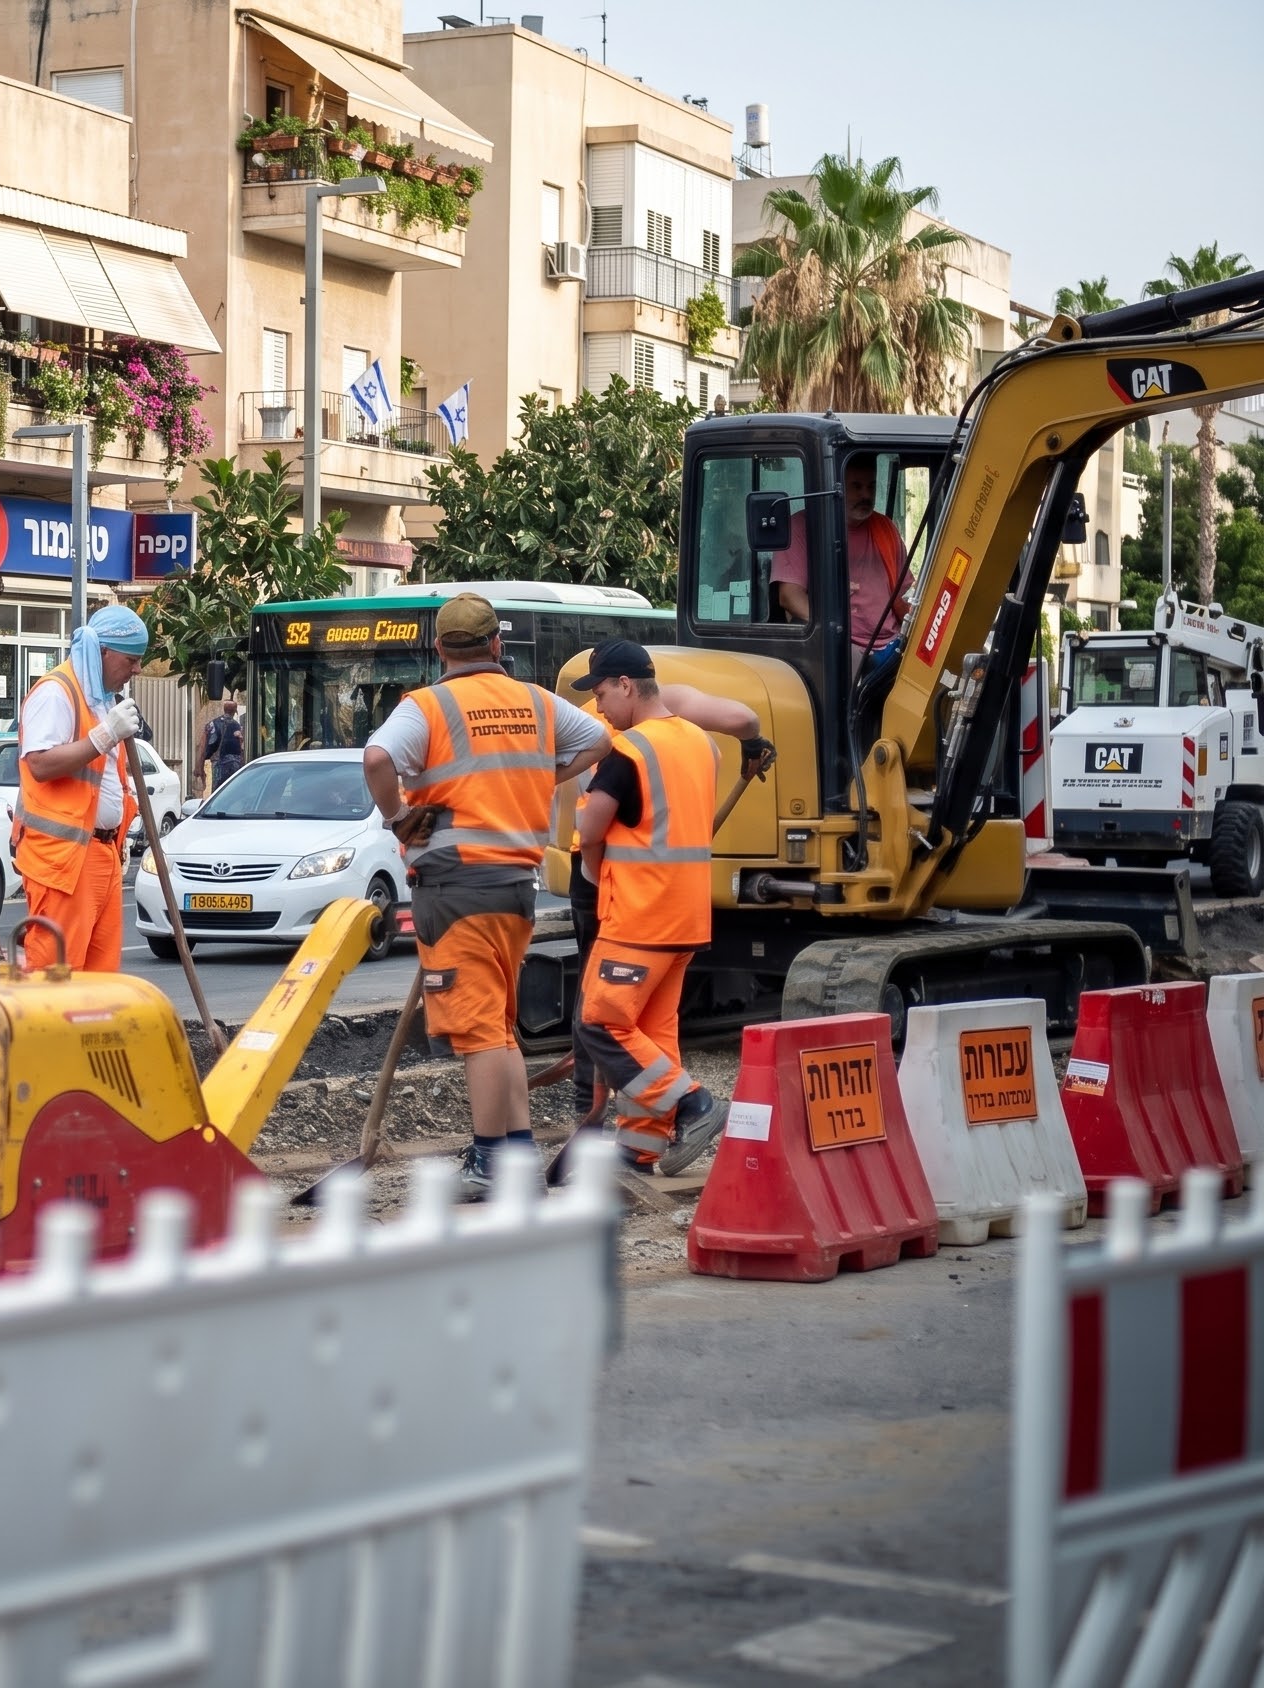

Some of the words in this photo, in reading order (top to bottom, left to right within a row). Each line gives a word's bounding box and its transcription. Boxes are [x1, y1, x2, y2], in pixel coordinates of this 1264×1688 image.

[1131, 363, 1172, 399] CAT
[139, 533, 187, 559] קפה
[1094, 747, 1133, 770] CAT
